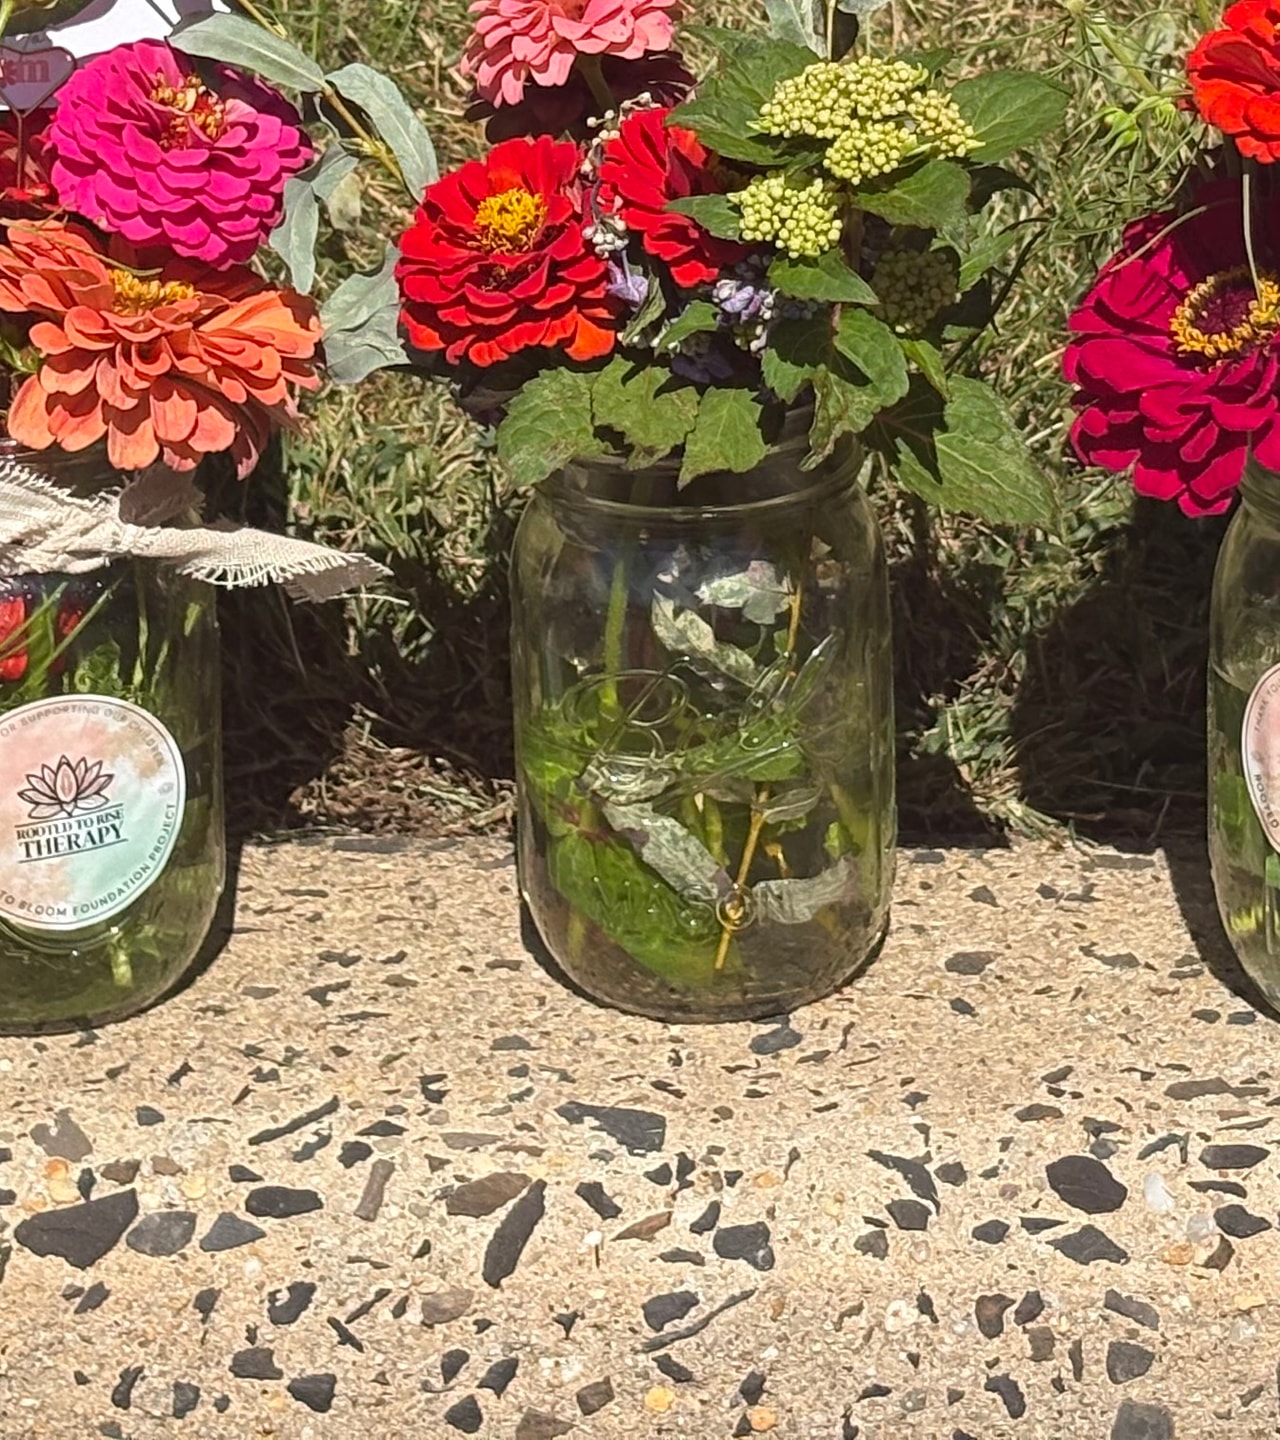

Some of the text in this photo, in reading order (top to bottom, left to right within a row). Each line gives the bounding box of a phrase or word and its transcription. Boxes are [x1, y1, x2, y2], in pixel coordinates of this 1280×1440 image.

[1255, 699, 1269, 732] THANK
[1254, 773, 1280, 830] ROOTED
[16, 808, 124, 841] ROOTED TO RISE
[19, 823, 121, 858] THERAPY
[19, 900, 67, 917] BLOOM
[73, 863, 151, 916] FOUNDATION
[149, 803, 176, 861] PROJECT
